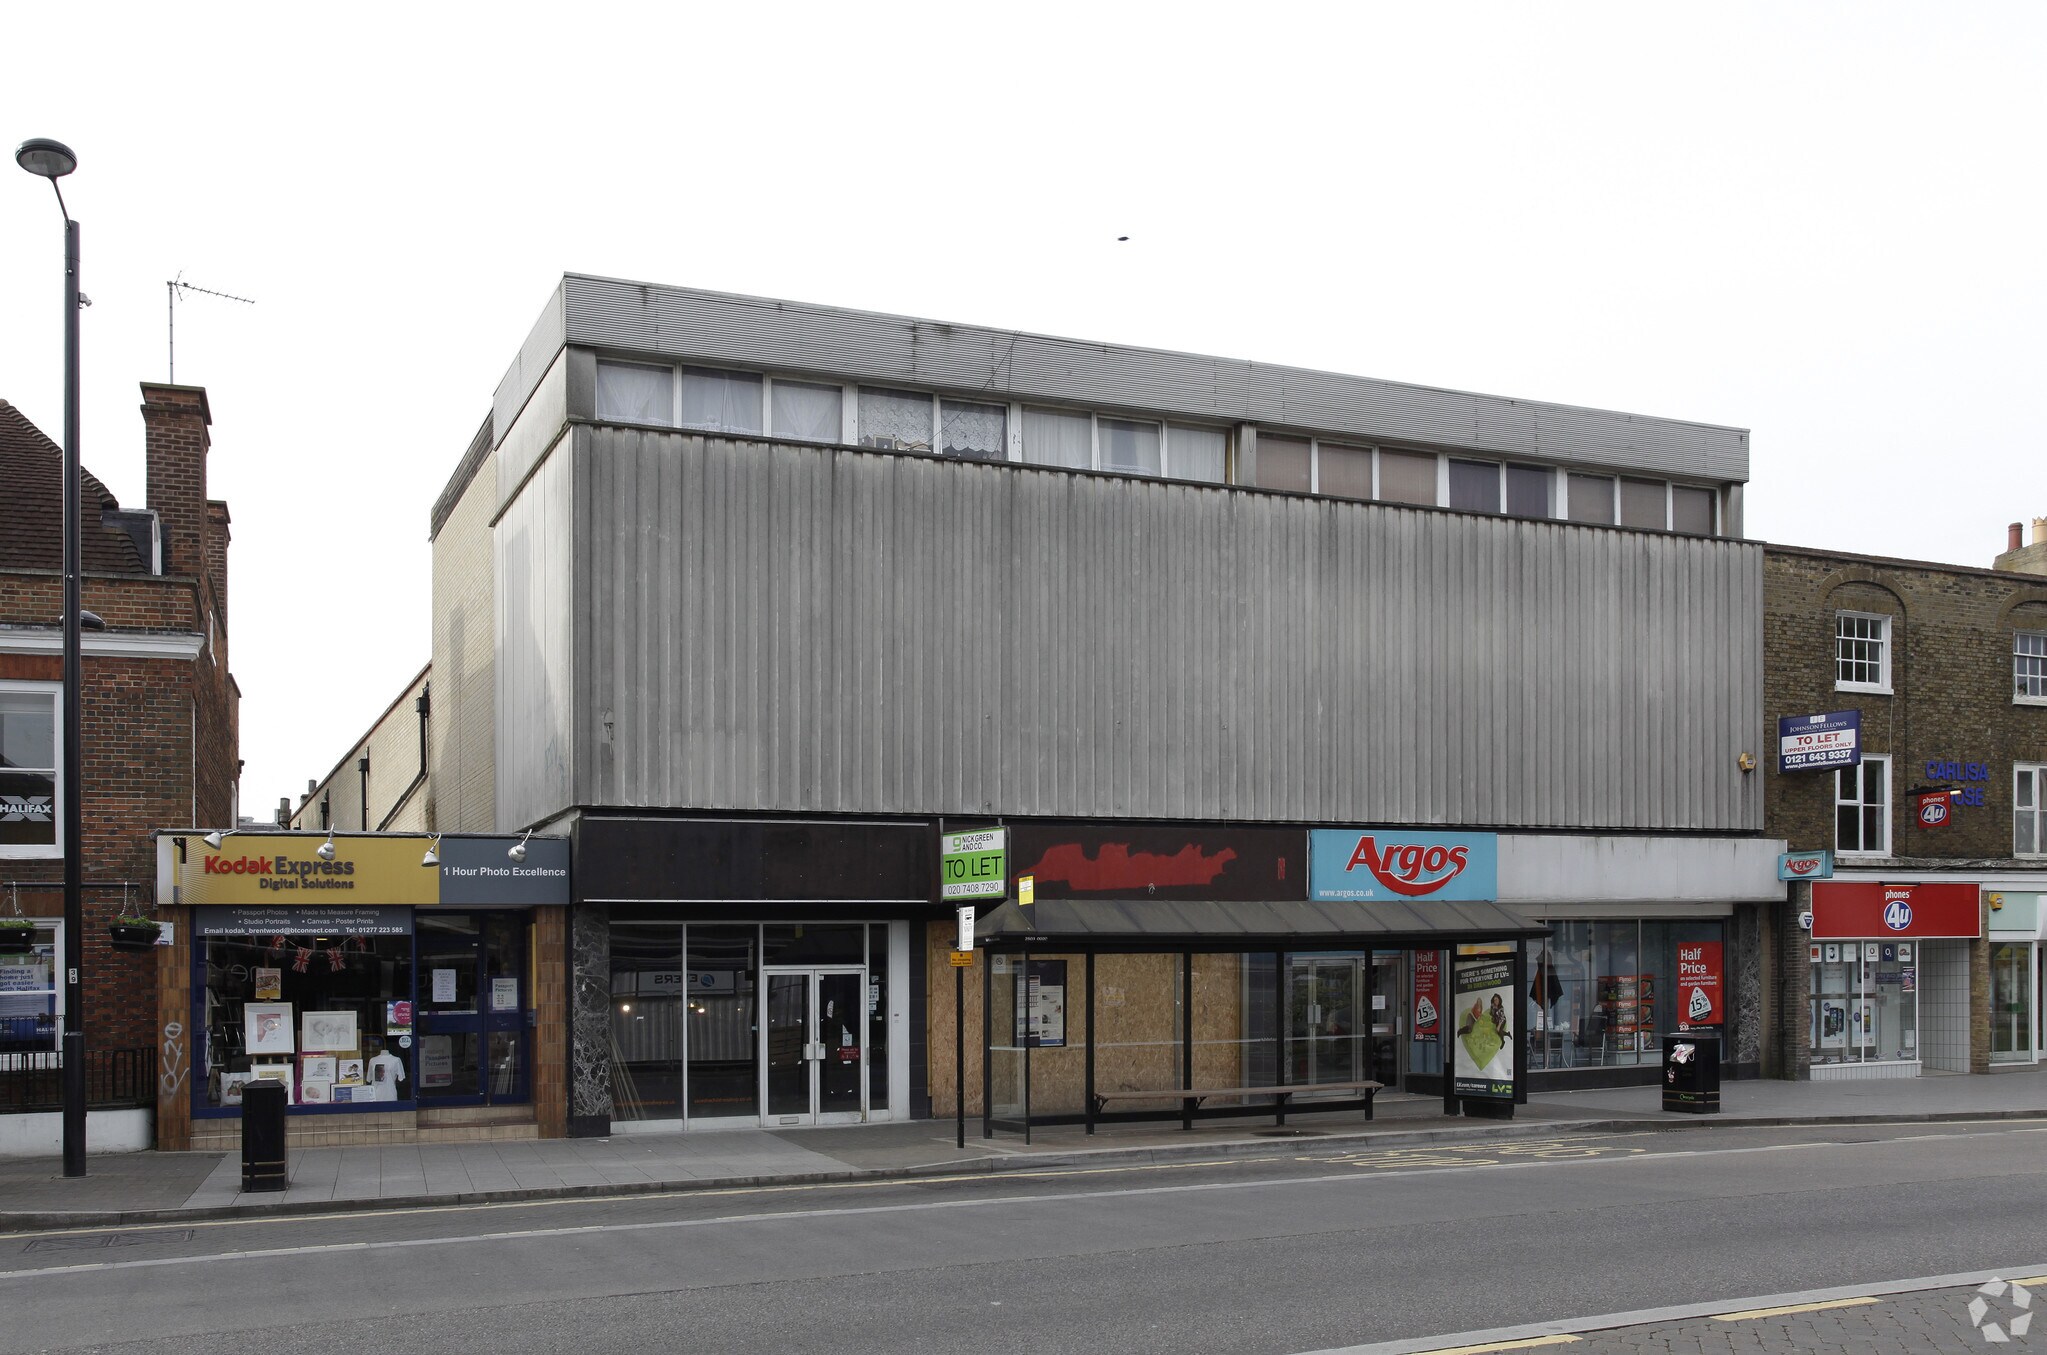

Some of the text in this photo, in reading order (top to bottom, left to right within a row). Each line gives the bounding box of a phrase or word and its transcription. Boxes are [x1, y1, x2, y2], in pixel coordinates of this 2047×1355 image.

[1789, 724, 1819, 734] JOHNSON
[1820, 721, 1847, 729] FELLOWS
[1797, 733, 1840, 746] TO LET
[1784, 746, 1806, 754] UPPER
[1785, 750, 1851, 764] 0121 643 9337
[1926, 760, 1989, 781] CARLISA
[1922, 796, 1945, 805] phones
[0, 804, 52, 813] HALIFAX
[204, 855, 354, 879] Kodak Express
[443, 866, 566, 877] 1 Hour Photo Excellence
[945, 856, 1002, 878] TO LET
[1345, 835, 1470, 897] Argos
[1785, 858, 1821, 875] Argos
[259, 878, 354, 890] Digital Solutions
[948, 882, 998, 895] 020 7408 7290
[1319, 889, 1374, 898] www.argos.co.uk
[1885, 889, 1910, 900] phones
[237, 909, 266, 917] Passport
[354, 909, 380, 917] Framing
[224, 927, 339, 935] kodak_brentwood@btconnect.com
[1416, 952, 1434, 962] Half
[1680, 948, 1702, 960] Half
[1416, 963, 1438, 973] Price
[1481, 965, 1507, 975] SOMETHING
[1680, 962, 1706, 974] Price
